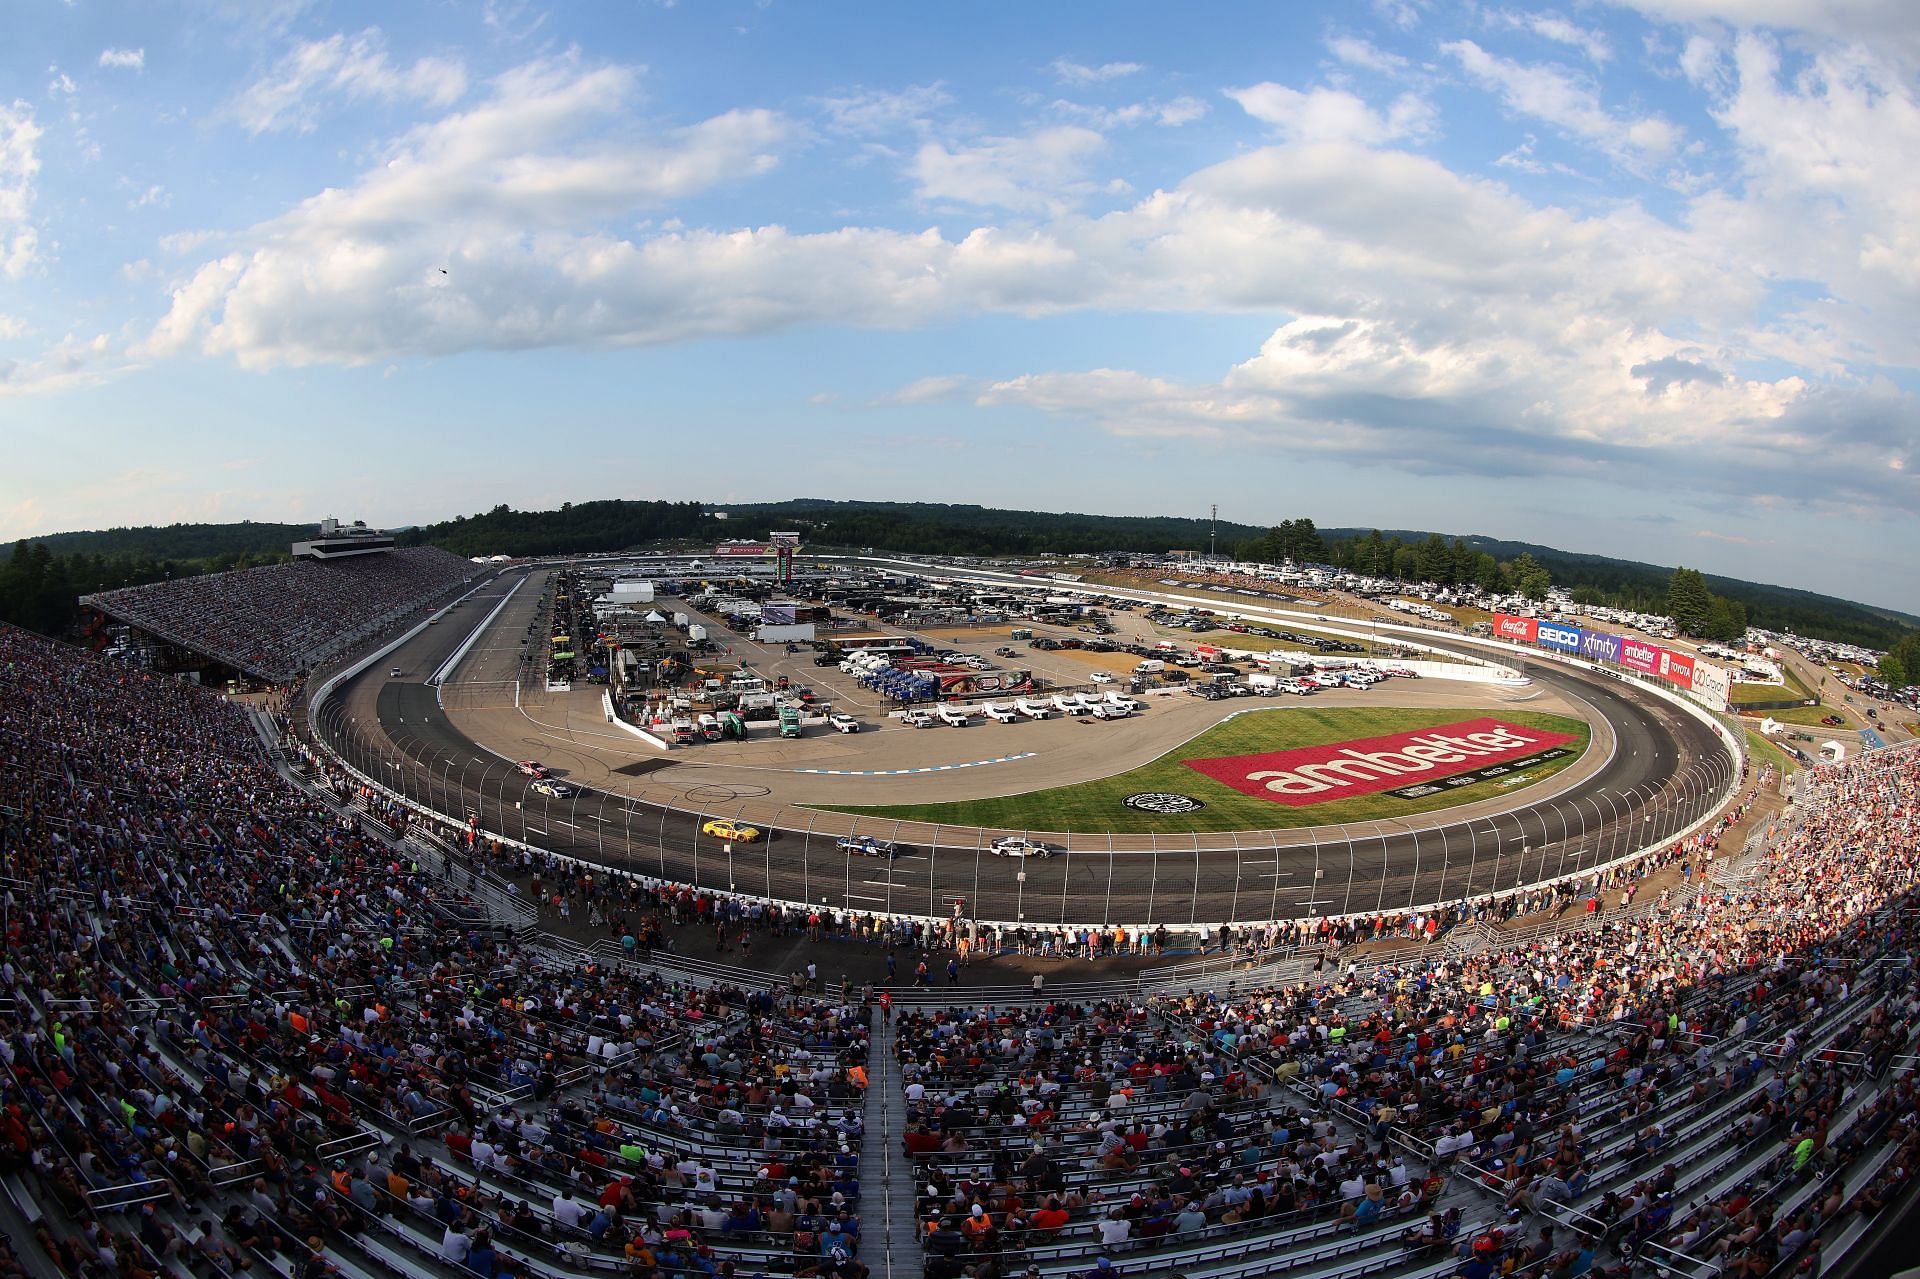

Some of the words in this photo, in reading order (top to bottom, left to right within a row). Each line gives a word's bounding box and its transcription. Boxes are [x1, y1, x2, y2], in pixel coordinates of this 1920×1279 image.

[1538, 627, 1578, 646] GEICO
[1584, 633, 1617, 659] xfinity
[1625, 645, 1655, 663] ambetter
[1671, 661, 1691, 678] TOYOTA
[1246, 725, 1539, 794] ambetter
